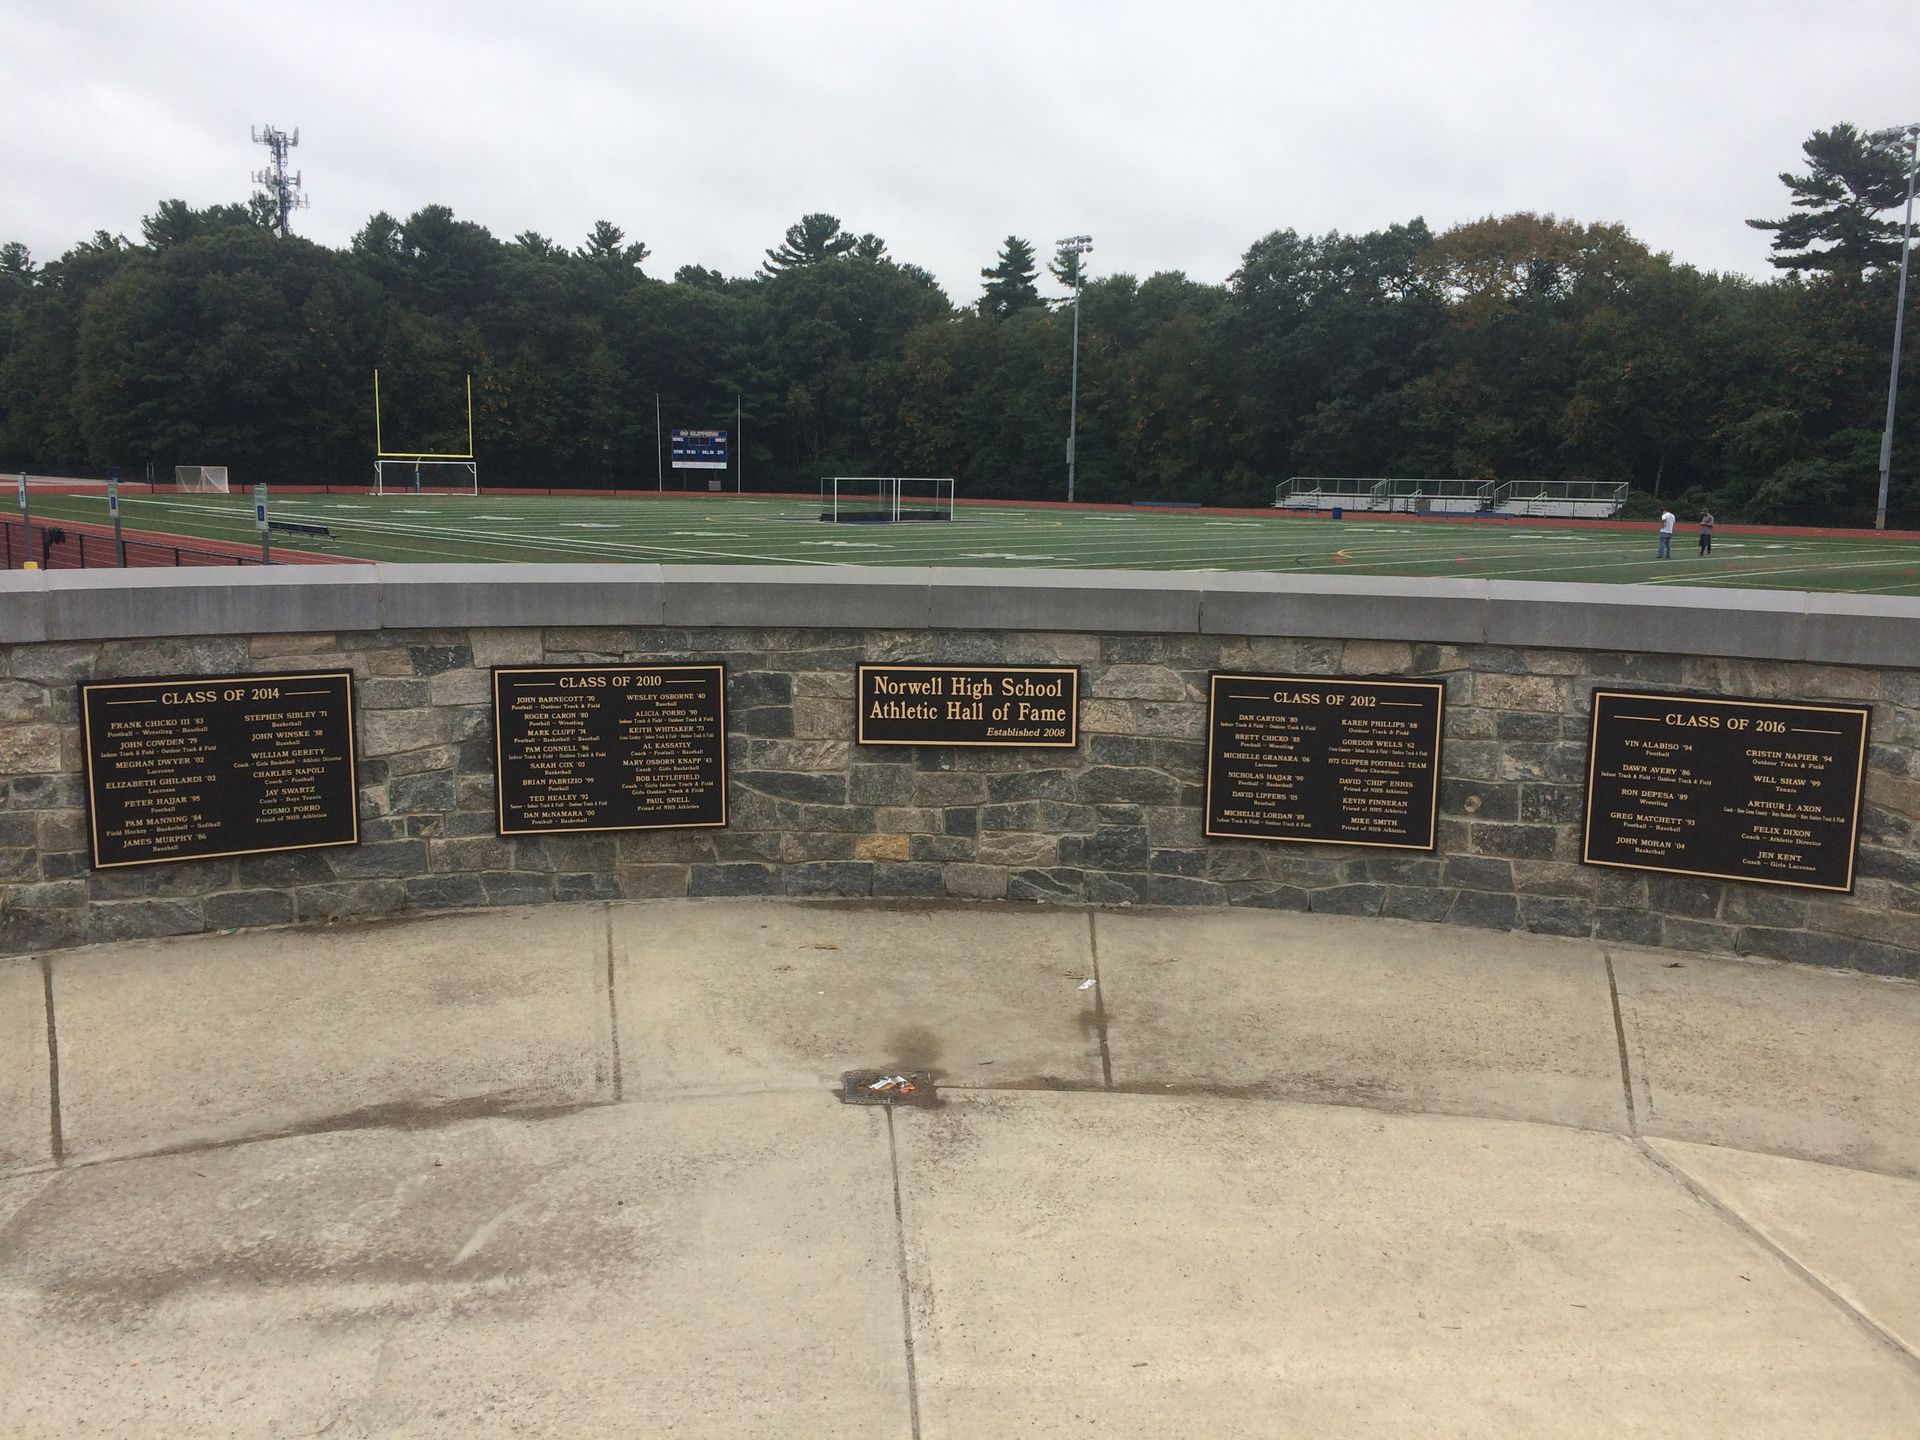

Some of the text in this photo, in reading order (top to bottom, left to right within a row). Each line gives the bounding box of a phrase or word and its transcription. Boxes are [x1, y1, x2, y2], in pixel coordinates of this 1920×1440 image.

[560, 676, 662, 688] CLASS OF 2010
[874, 676, 1062, 699] Norwell High School
[162, 688, 279, 704] CLASS OF 2014
[1274, 692, 1376, 707] CLASS OF 2012
[870, 701, 1066, 721] Athletic Hall of Fame
[1666, 713, 1786, 733] CLASS OF 2016
[251, 733, 272, 741] JOHN
[986, 728, 1065, 737] Established 2008
[1642, 742, 1679, 750] ALABISO
[251, 751, 289, 759] WILLIAM
[1746, 750, 1818, 761] CRISTIN NAPIER
[116, 760, 154, 769] MEGHAN
[253, 770, 292, 778] CHARLES
[106, 779, 156, 789] ELIZABETH
[160, 776, 202, 785] GHILARDI
[1641, 791, 1674, 800] DEPESA
[124, 797, 187, 807] PETER HAJJAR
[1748, 801, 1785, 810] ARTHUR
[147, 816, 188, 825] MANNING
[1637, 815, 1682, 824] MATCHETT
[1753, 826, 1811, 837] FELIX DIXON
[123, 835, 192, 848] JAMES MURPHY
[1641, 840, 1671, 848] MOHAN
